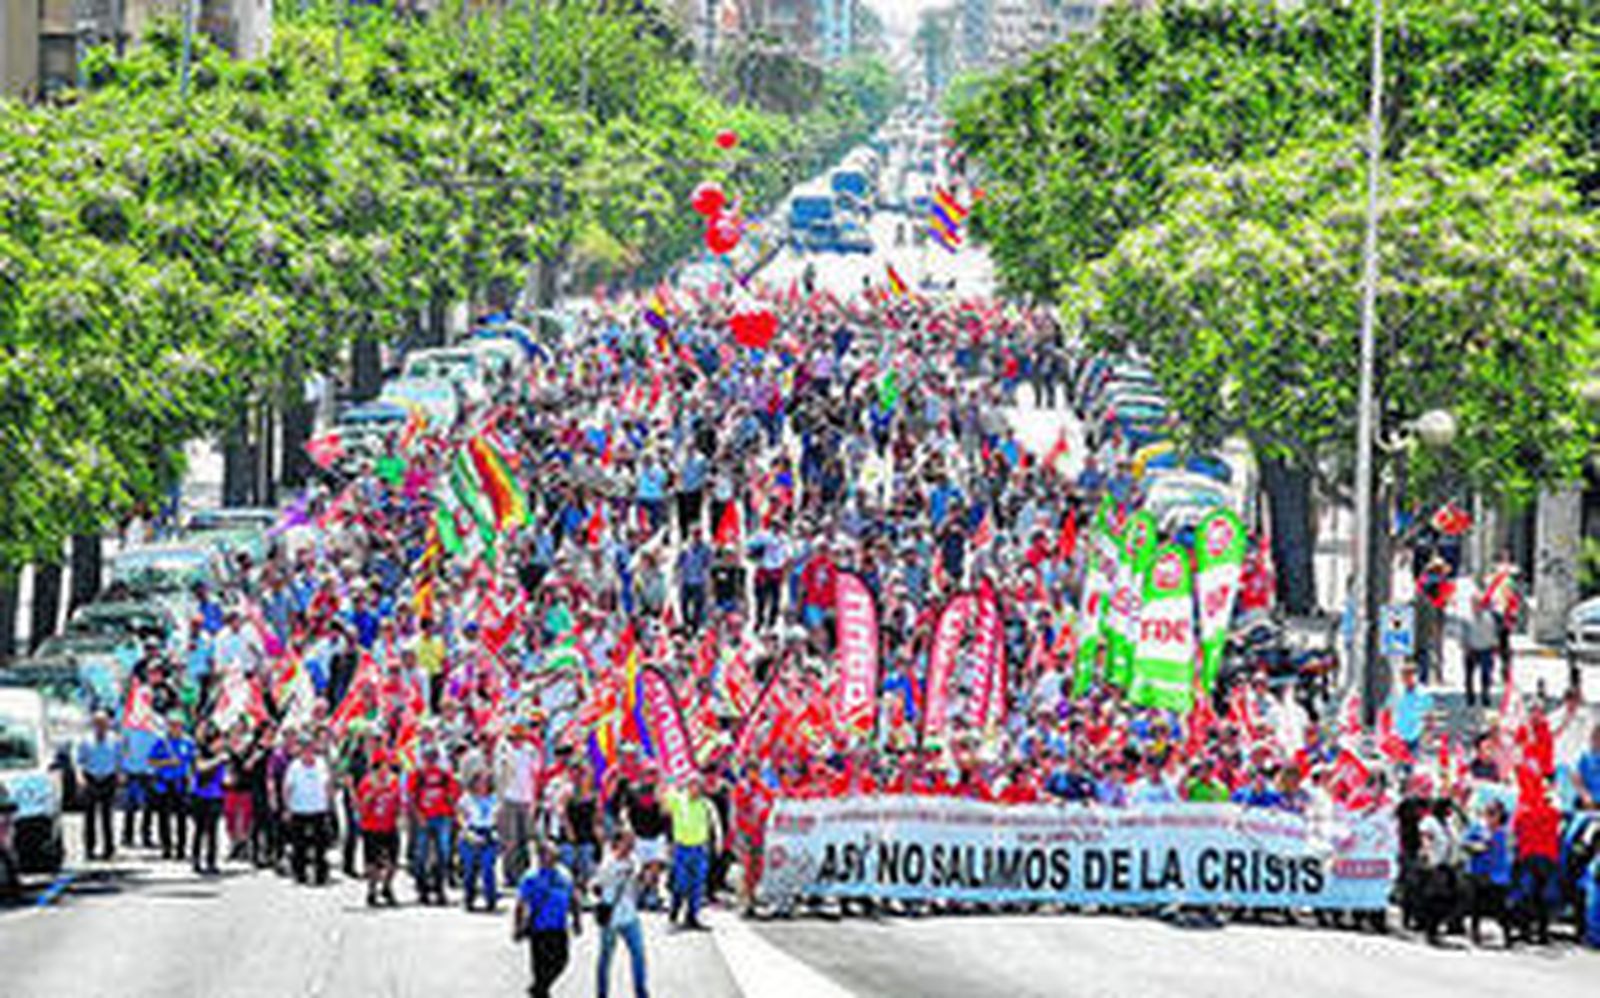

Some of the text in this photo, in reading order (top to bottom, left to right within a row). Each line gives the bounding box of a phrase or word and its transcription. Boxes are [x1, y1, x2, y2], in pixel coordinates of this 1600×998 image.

[877, 840, 927, 885] NO
[930, 844, 1071, 890] SALIMOS
[1083, 849, 1131, 890] DE
[1140, 848, 1185, 890] LA
